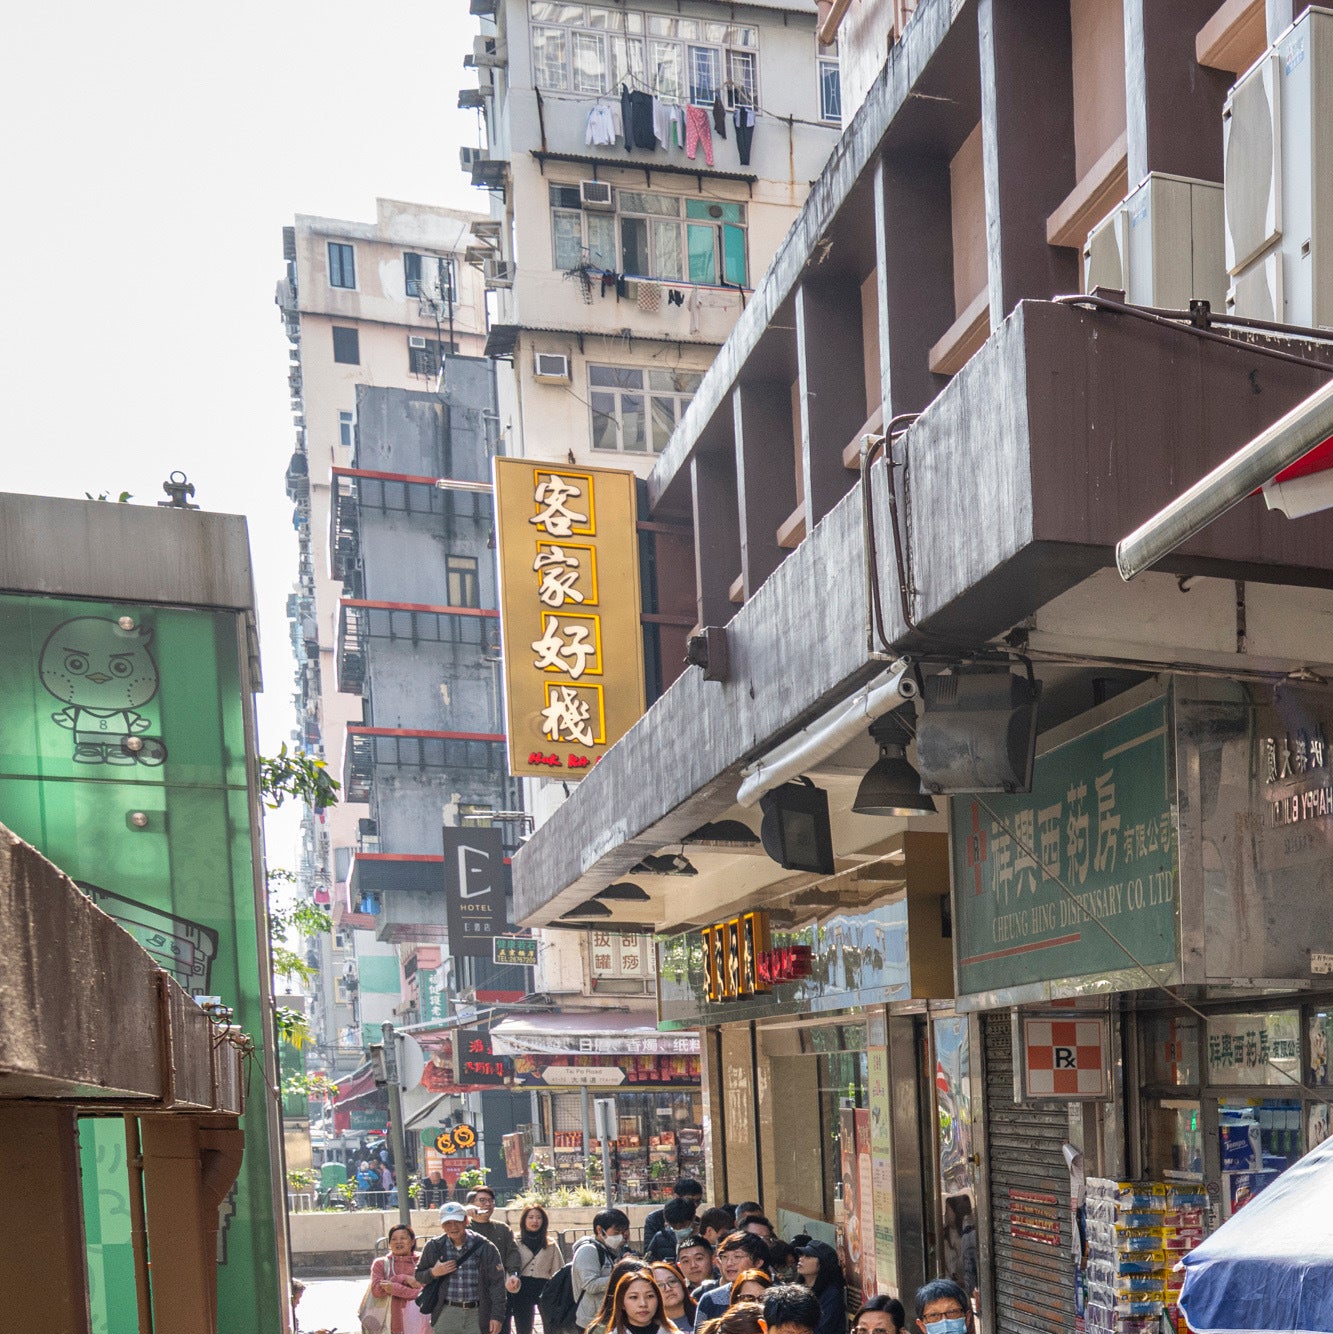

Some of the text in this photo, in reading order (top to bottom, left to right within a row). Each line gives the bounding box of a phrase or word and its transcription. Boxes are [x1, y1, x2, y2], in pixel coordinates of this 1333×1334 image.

[99, 719, 107, 730] 8
[460, 904, 492, 912] HOTEL
[992, 910, 1028, 943] CHEUNG
[1032, 902, 1056, 934] HING
[1059, 882, 1123, 928] DISPENSARY
[1127, 878, 1146, 911] CO.
[1222, 1136, 1247, 1151] Tempo
